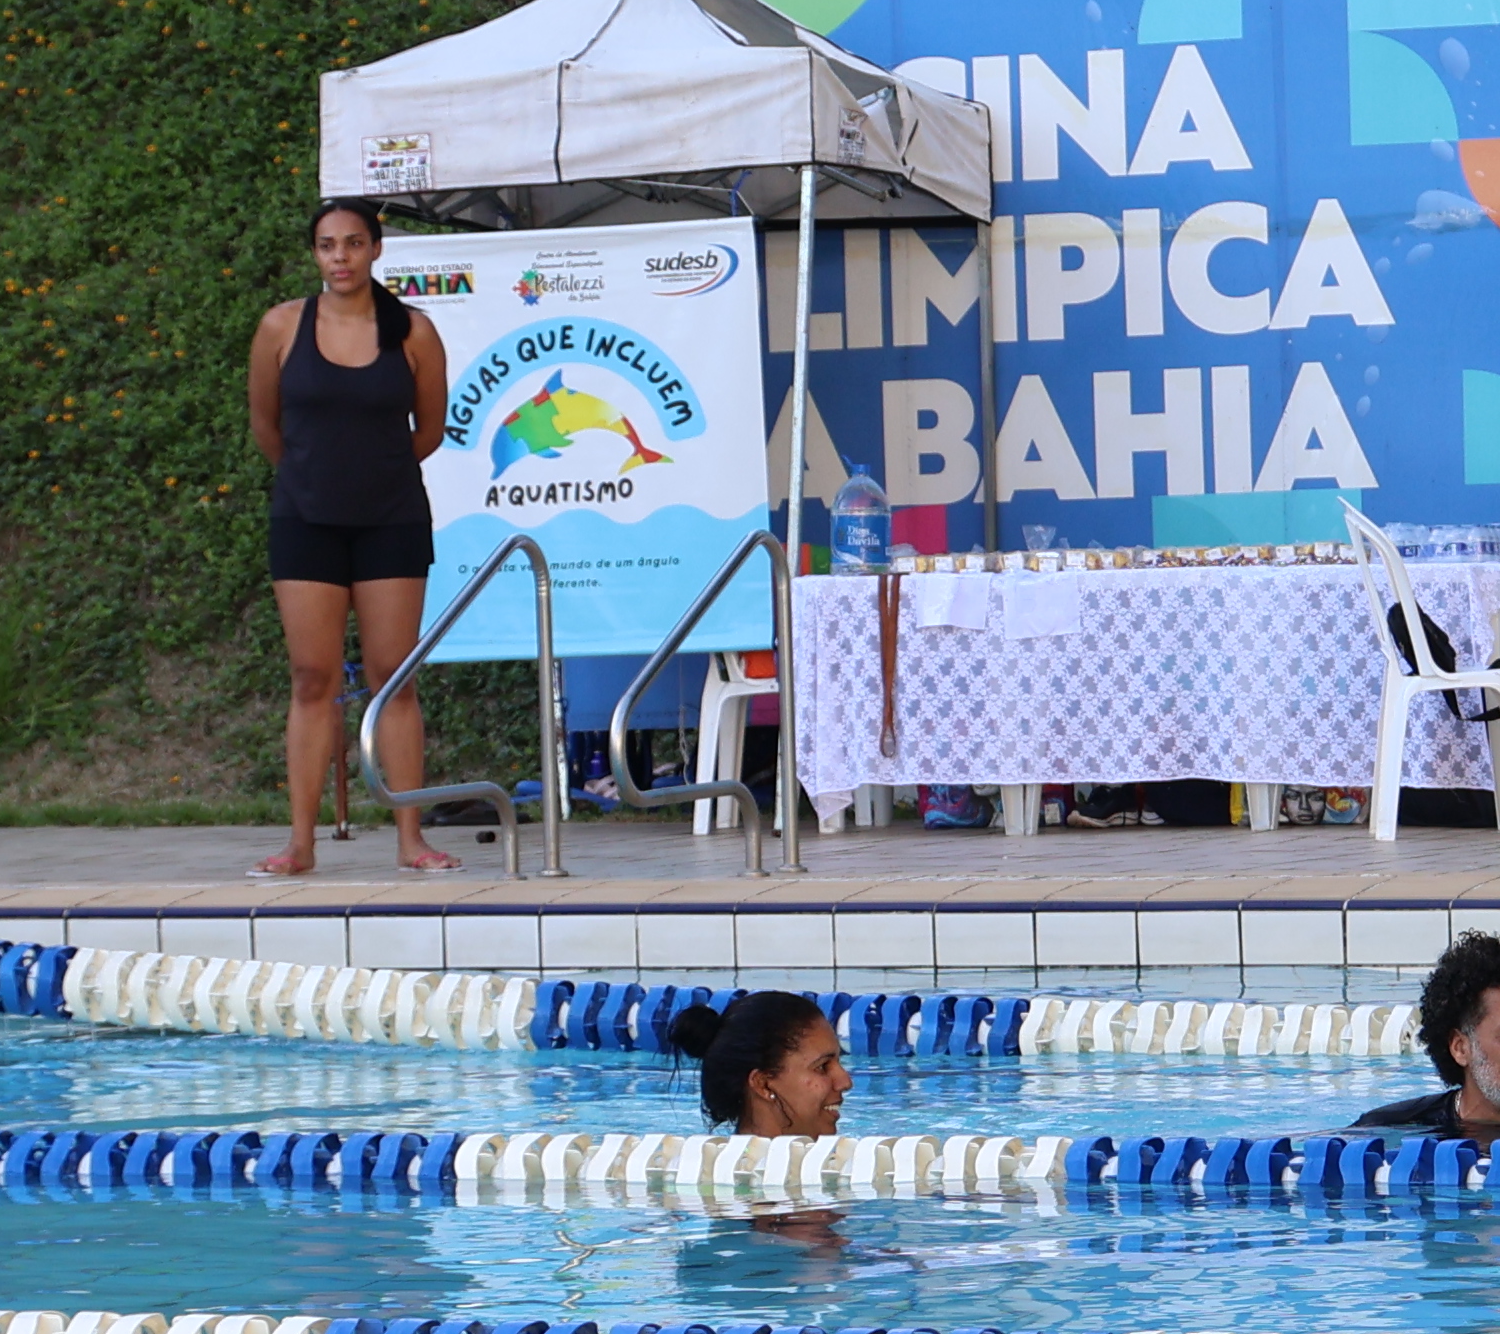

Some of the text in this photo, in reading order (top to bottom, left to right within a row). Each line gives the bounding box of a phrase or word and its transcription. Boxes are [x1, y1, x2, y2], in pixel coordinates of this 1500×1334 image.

[383, 263, 473, 275] GOVERNO DO ESTADO
[643, 249, 718, 273] sudesb
[384, 273, 474, 297] BAHIA
[534, 272, 605, 293] Pestalozzi
[516, 324, 575, 363] QUE
[585, 328, 693, 427] INCLUEM
[882, 362, 1380, 507] BAHIA
[550, 558, 591, 570] mundo
[596, 558, 611, 568] de
[615, 558, 633, 568] um
[637, 555, 680, 569] ângulo
